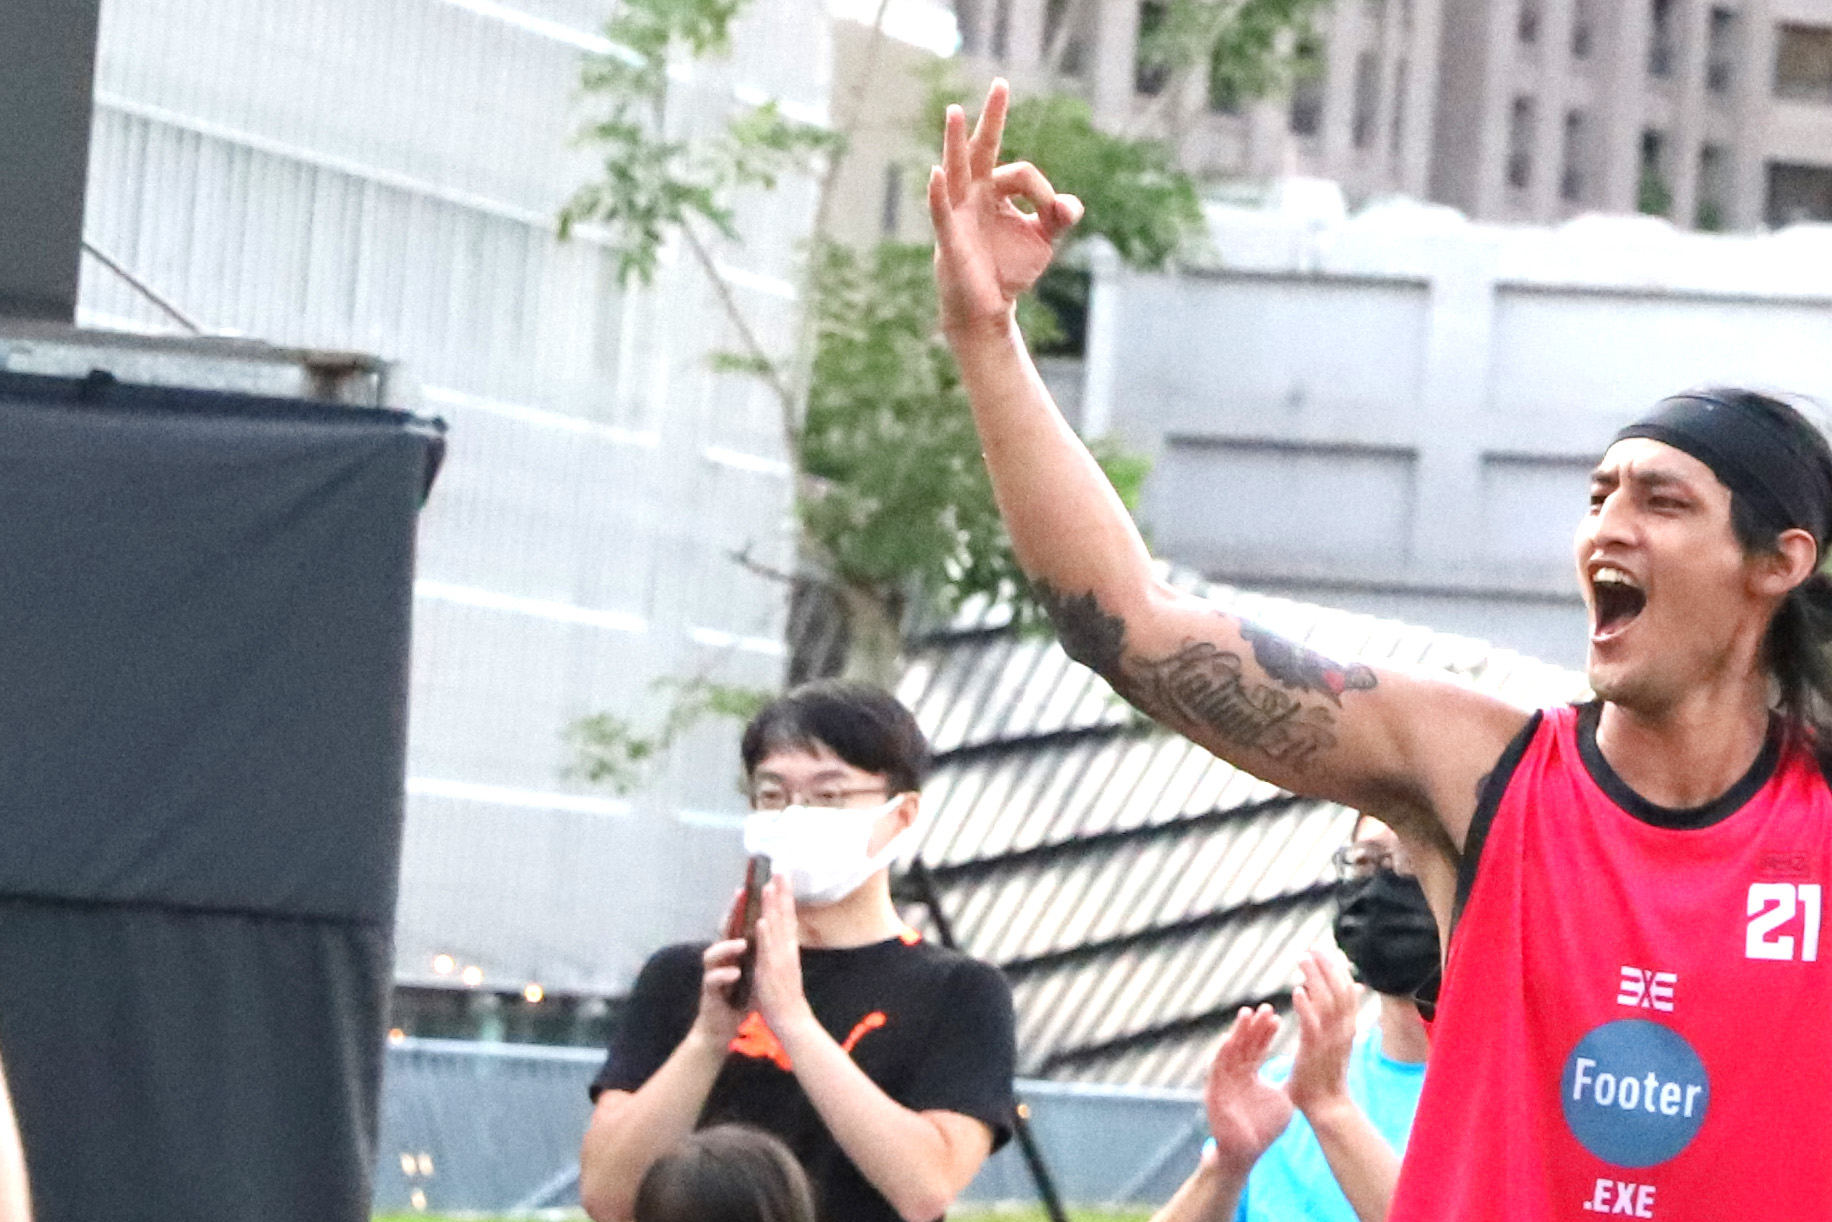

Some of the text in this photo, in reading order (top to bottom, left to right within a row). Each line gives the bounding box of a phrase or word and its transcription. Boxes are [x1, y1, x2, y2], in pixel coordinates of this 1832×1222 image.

[1745, 883, 1822, 962] 21
[1572, 1056, 1702, 1118] Footer
[1583, 1178, 1656, 1219] .EXE
